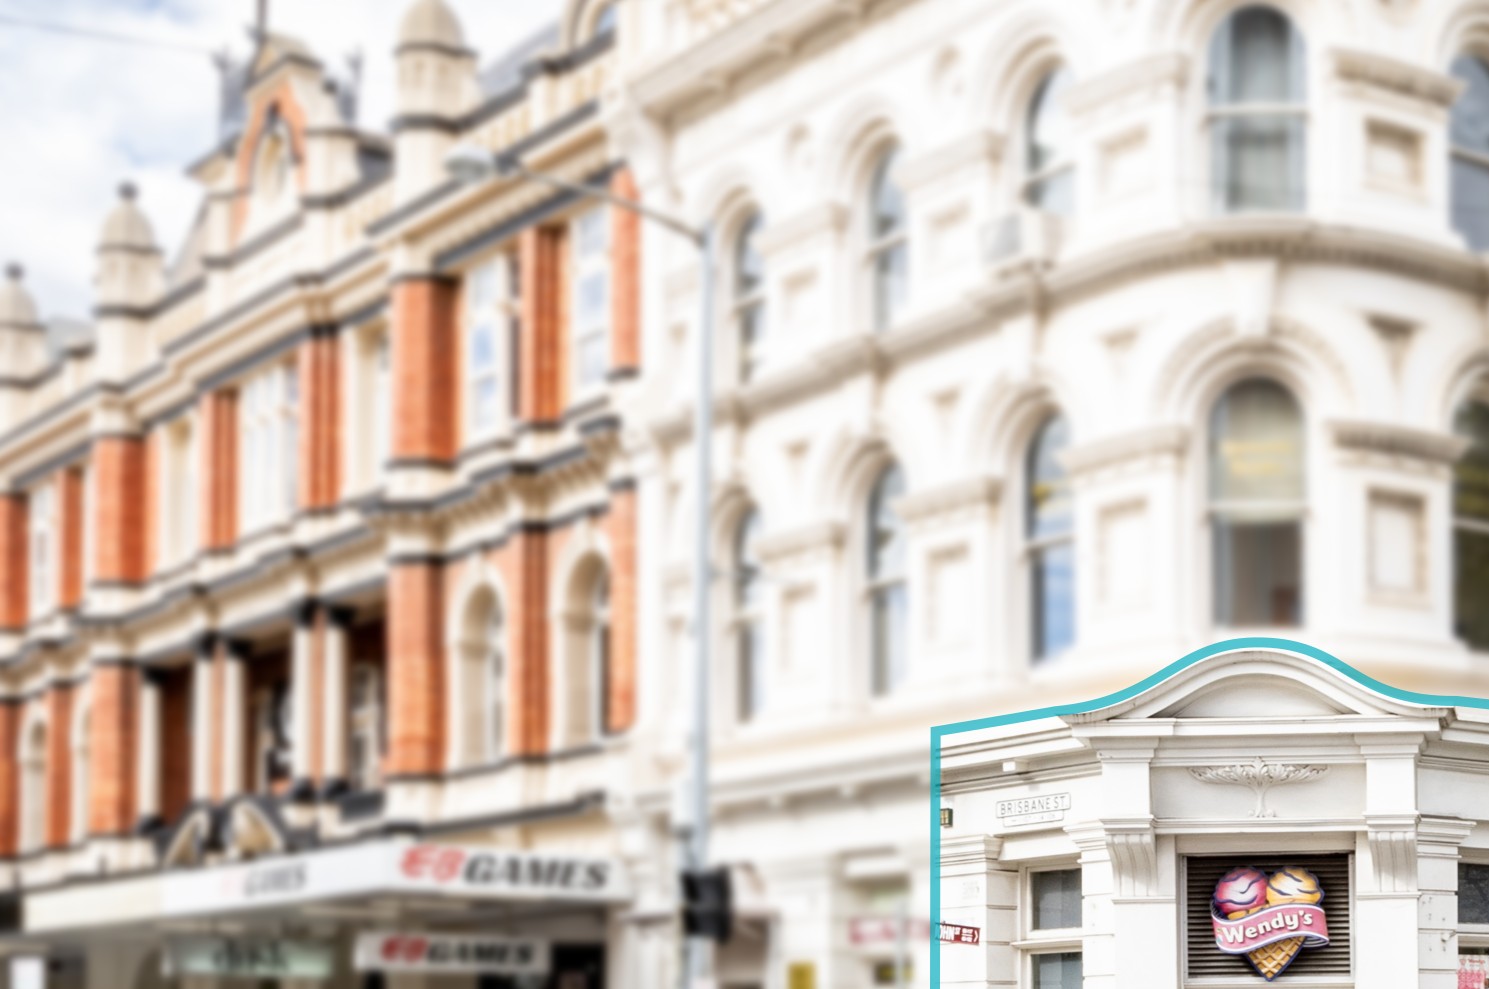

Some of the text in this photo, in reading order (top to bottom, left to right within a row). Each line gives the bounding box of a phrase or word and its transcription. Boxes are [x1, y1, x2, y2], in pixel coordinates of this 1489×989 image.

[1000, 797, 1051, 815] BRISBANE
[464, 854, 608, 888] GAMES
[1222, 910, 1313, 943] Wendy's
[427, 942, 534, 965] GAMES
